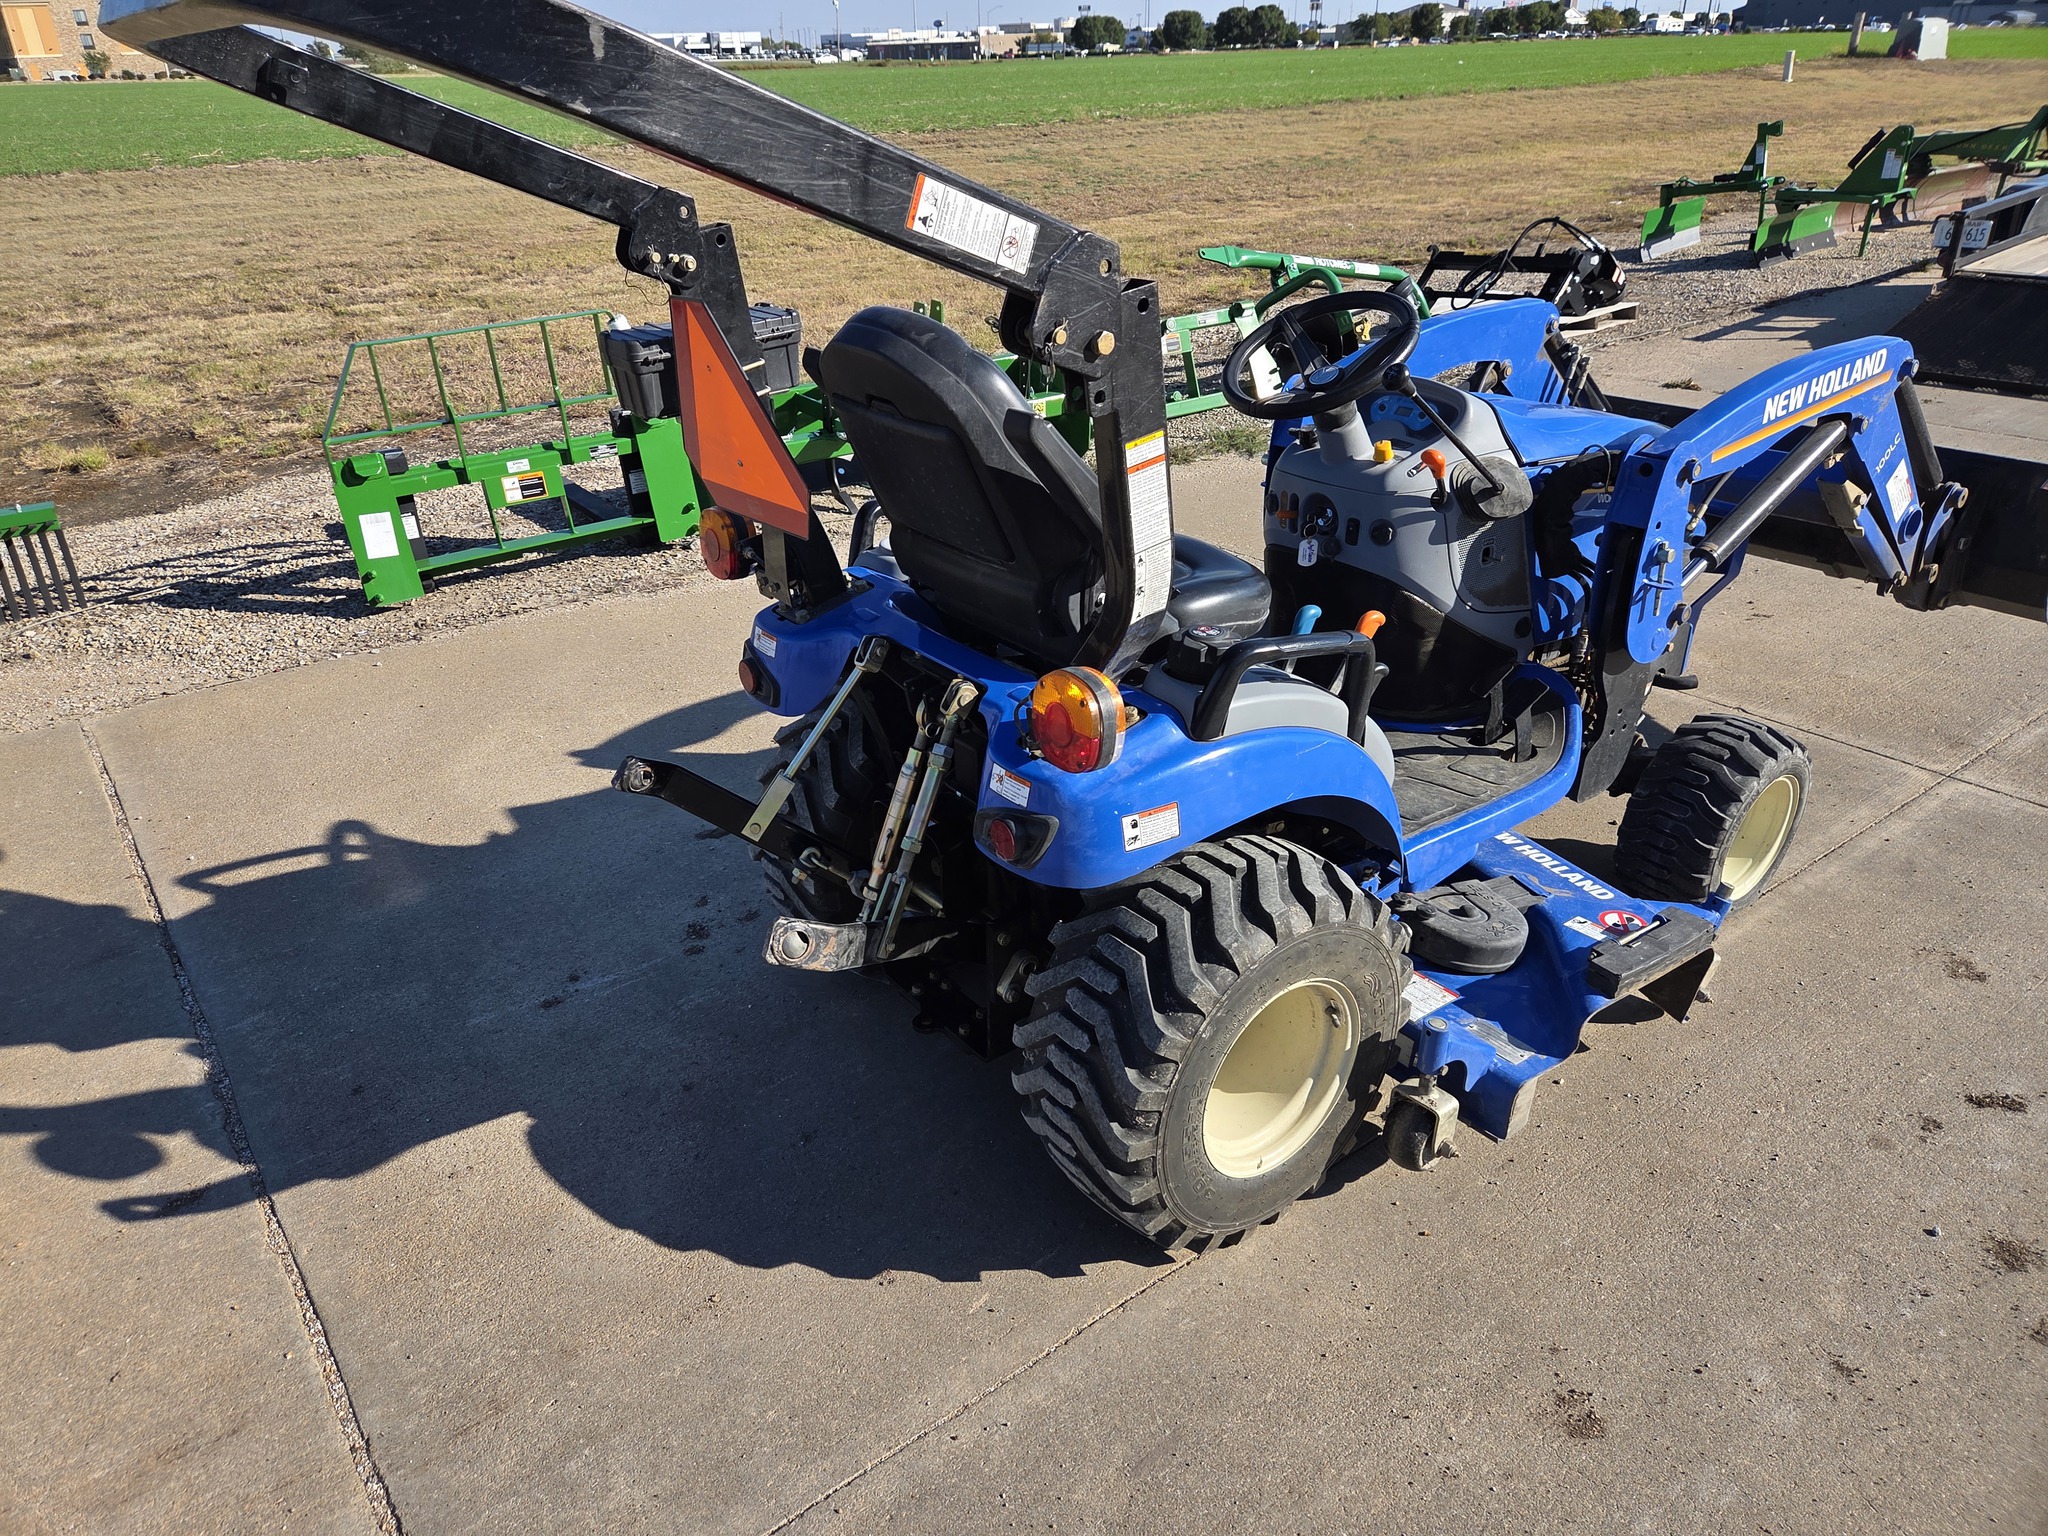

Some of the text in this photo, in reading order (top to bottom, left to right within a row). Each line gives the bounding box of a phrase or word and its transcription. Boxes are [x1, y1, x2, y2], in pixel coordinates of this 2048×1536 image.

[1965, 227, 1987, 242] 615
[1762, 347, 1888, 425] NEW HOLLAND
[1875, 432, 1902, 474] 100LC
[1514, 844, 1615, 900] HOLLAND
